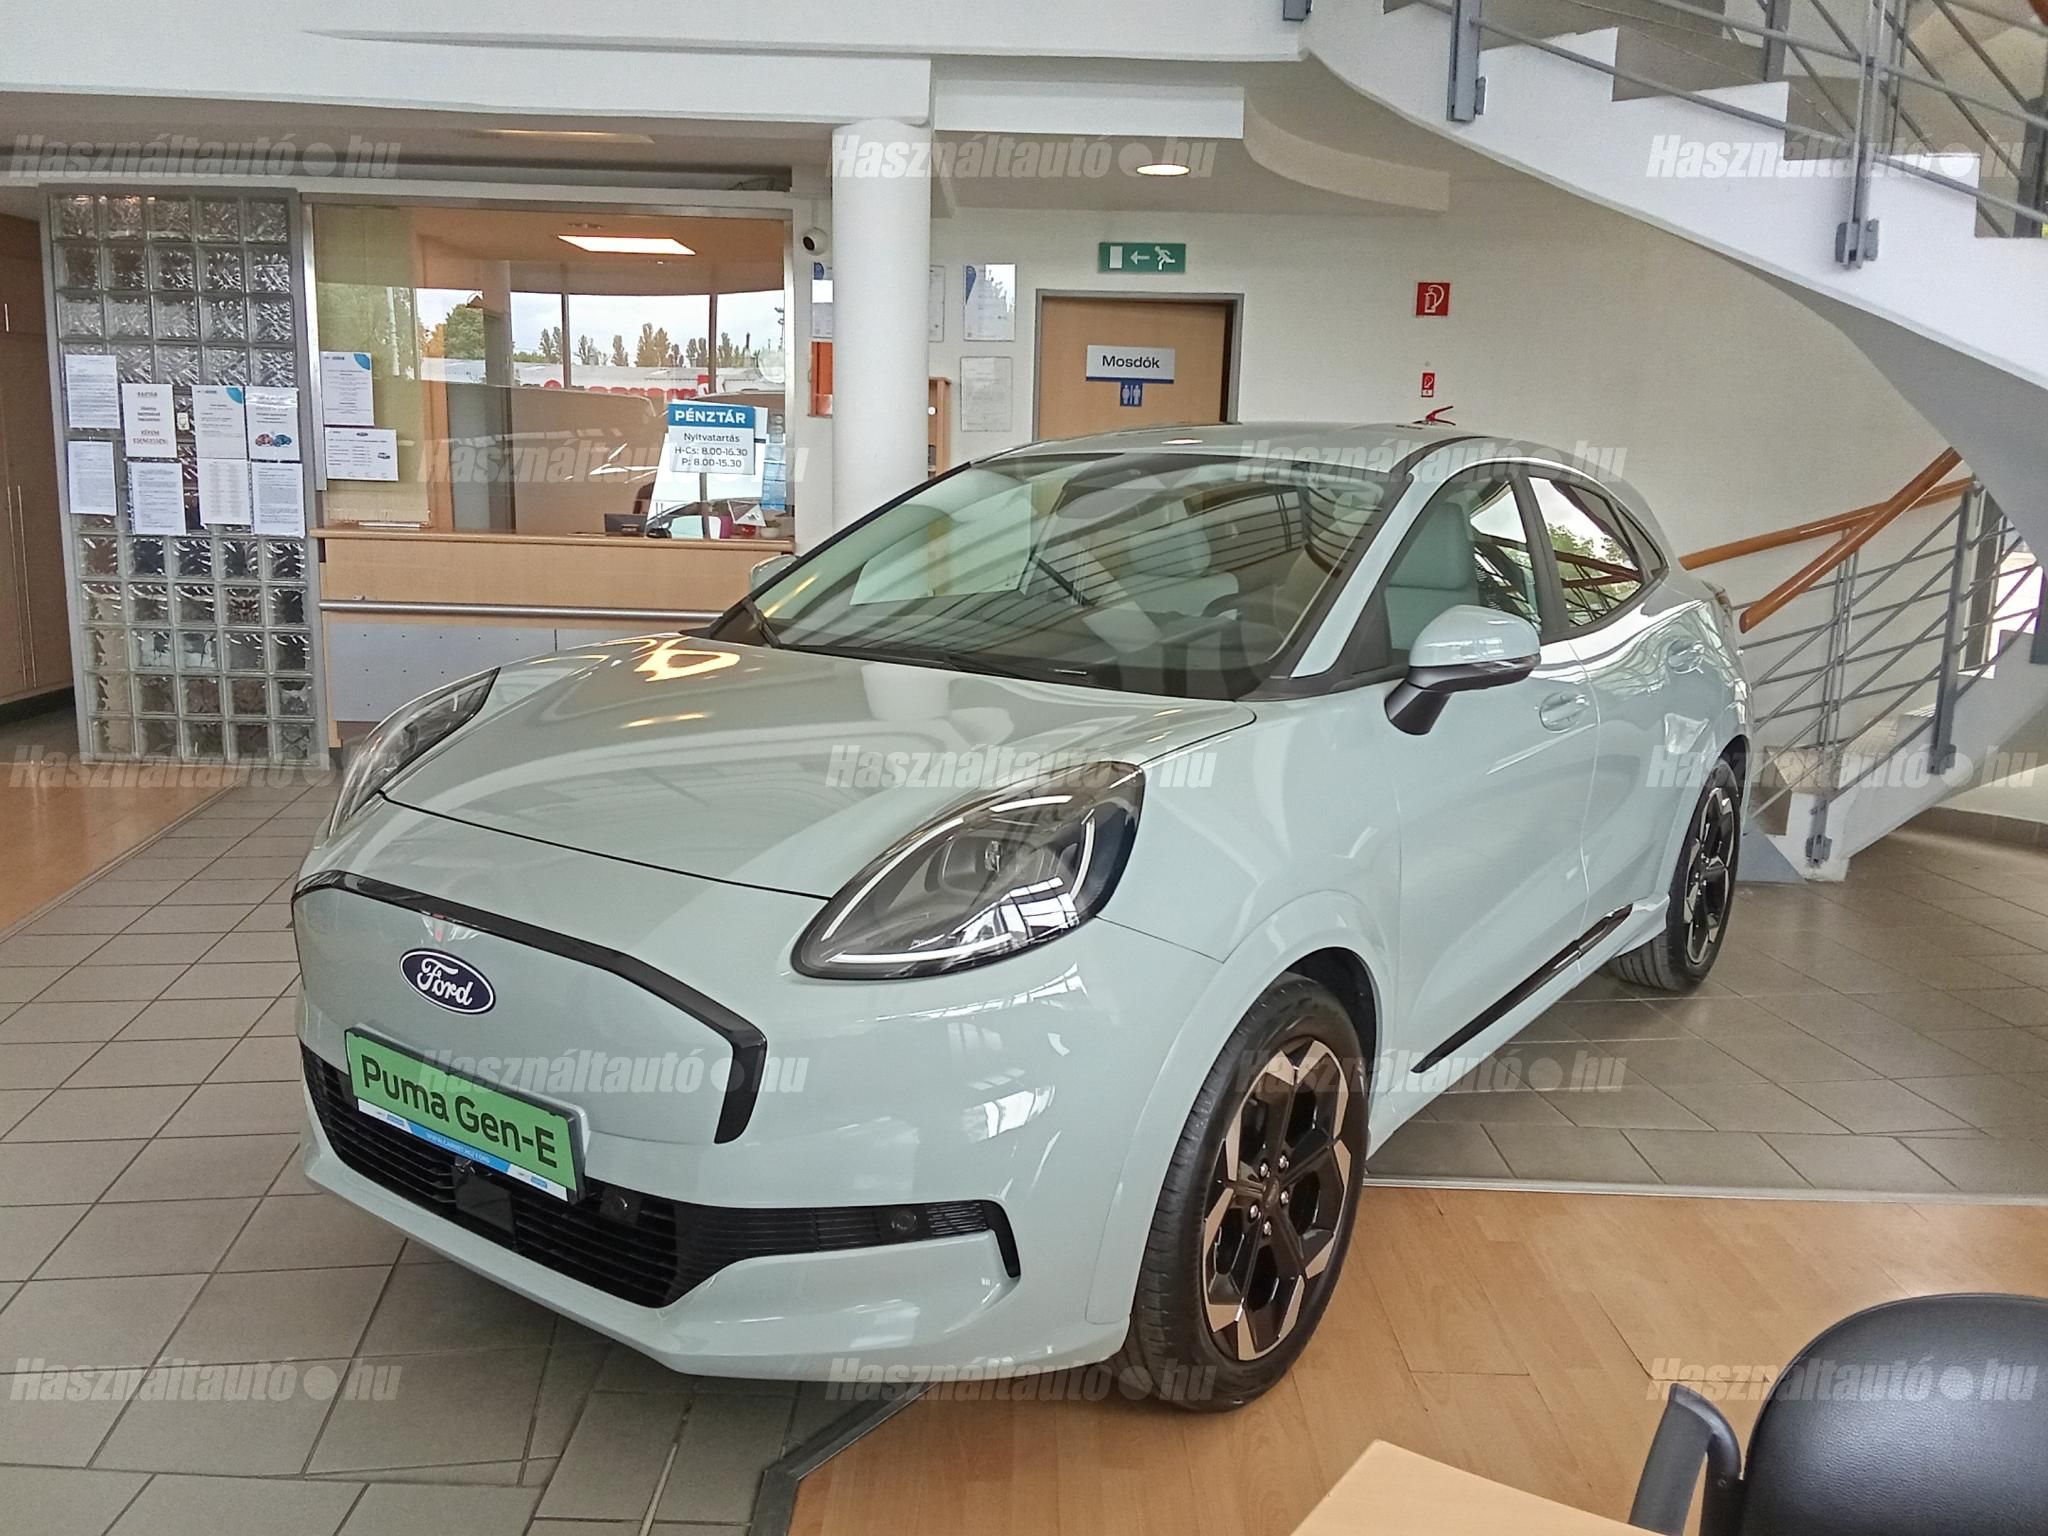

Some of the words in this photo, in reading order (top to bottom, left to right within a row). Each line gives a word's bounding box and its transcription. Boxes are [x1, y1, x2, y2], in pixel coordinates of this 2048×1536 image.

[1102, 354, 1160, 369] Mosdók
[675, 408, 746, 424] PÉNZTÁR
[683, 432, 740, 443] Nyitvatartás
[701, 447, 748, 457] 8.00-16.30
[693, 458, 742, 468] 8.00-15.30
[416, 956, 475, 1007] Ford
[360, 1053, 450, 1123] Puma
[454, 1094, 558, 1169] Gen-E
